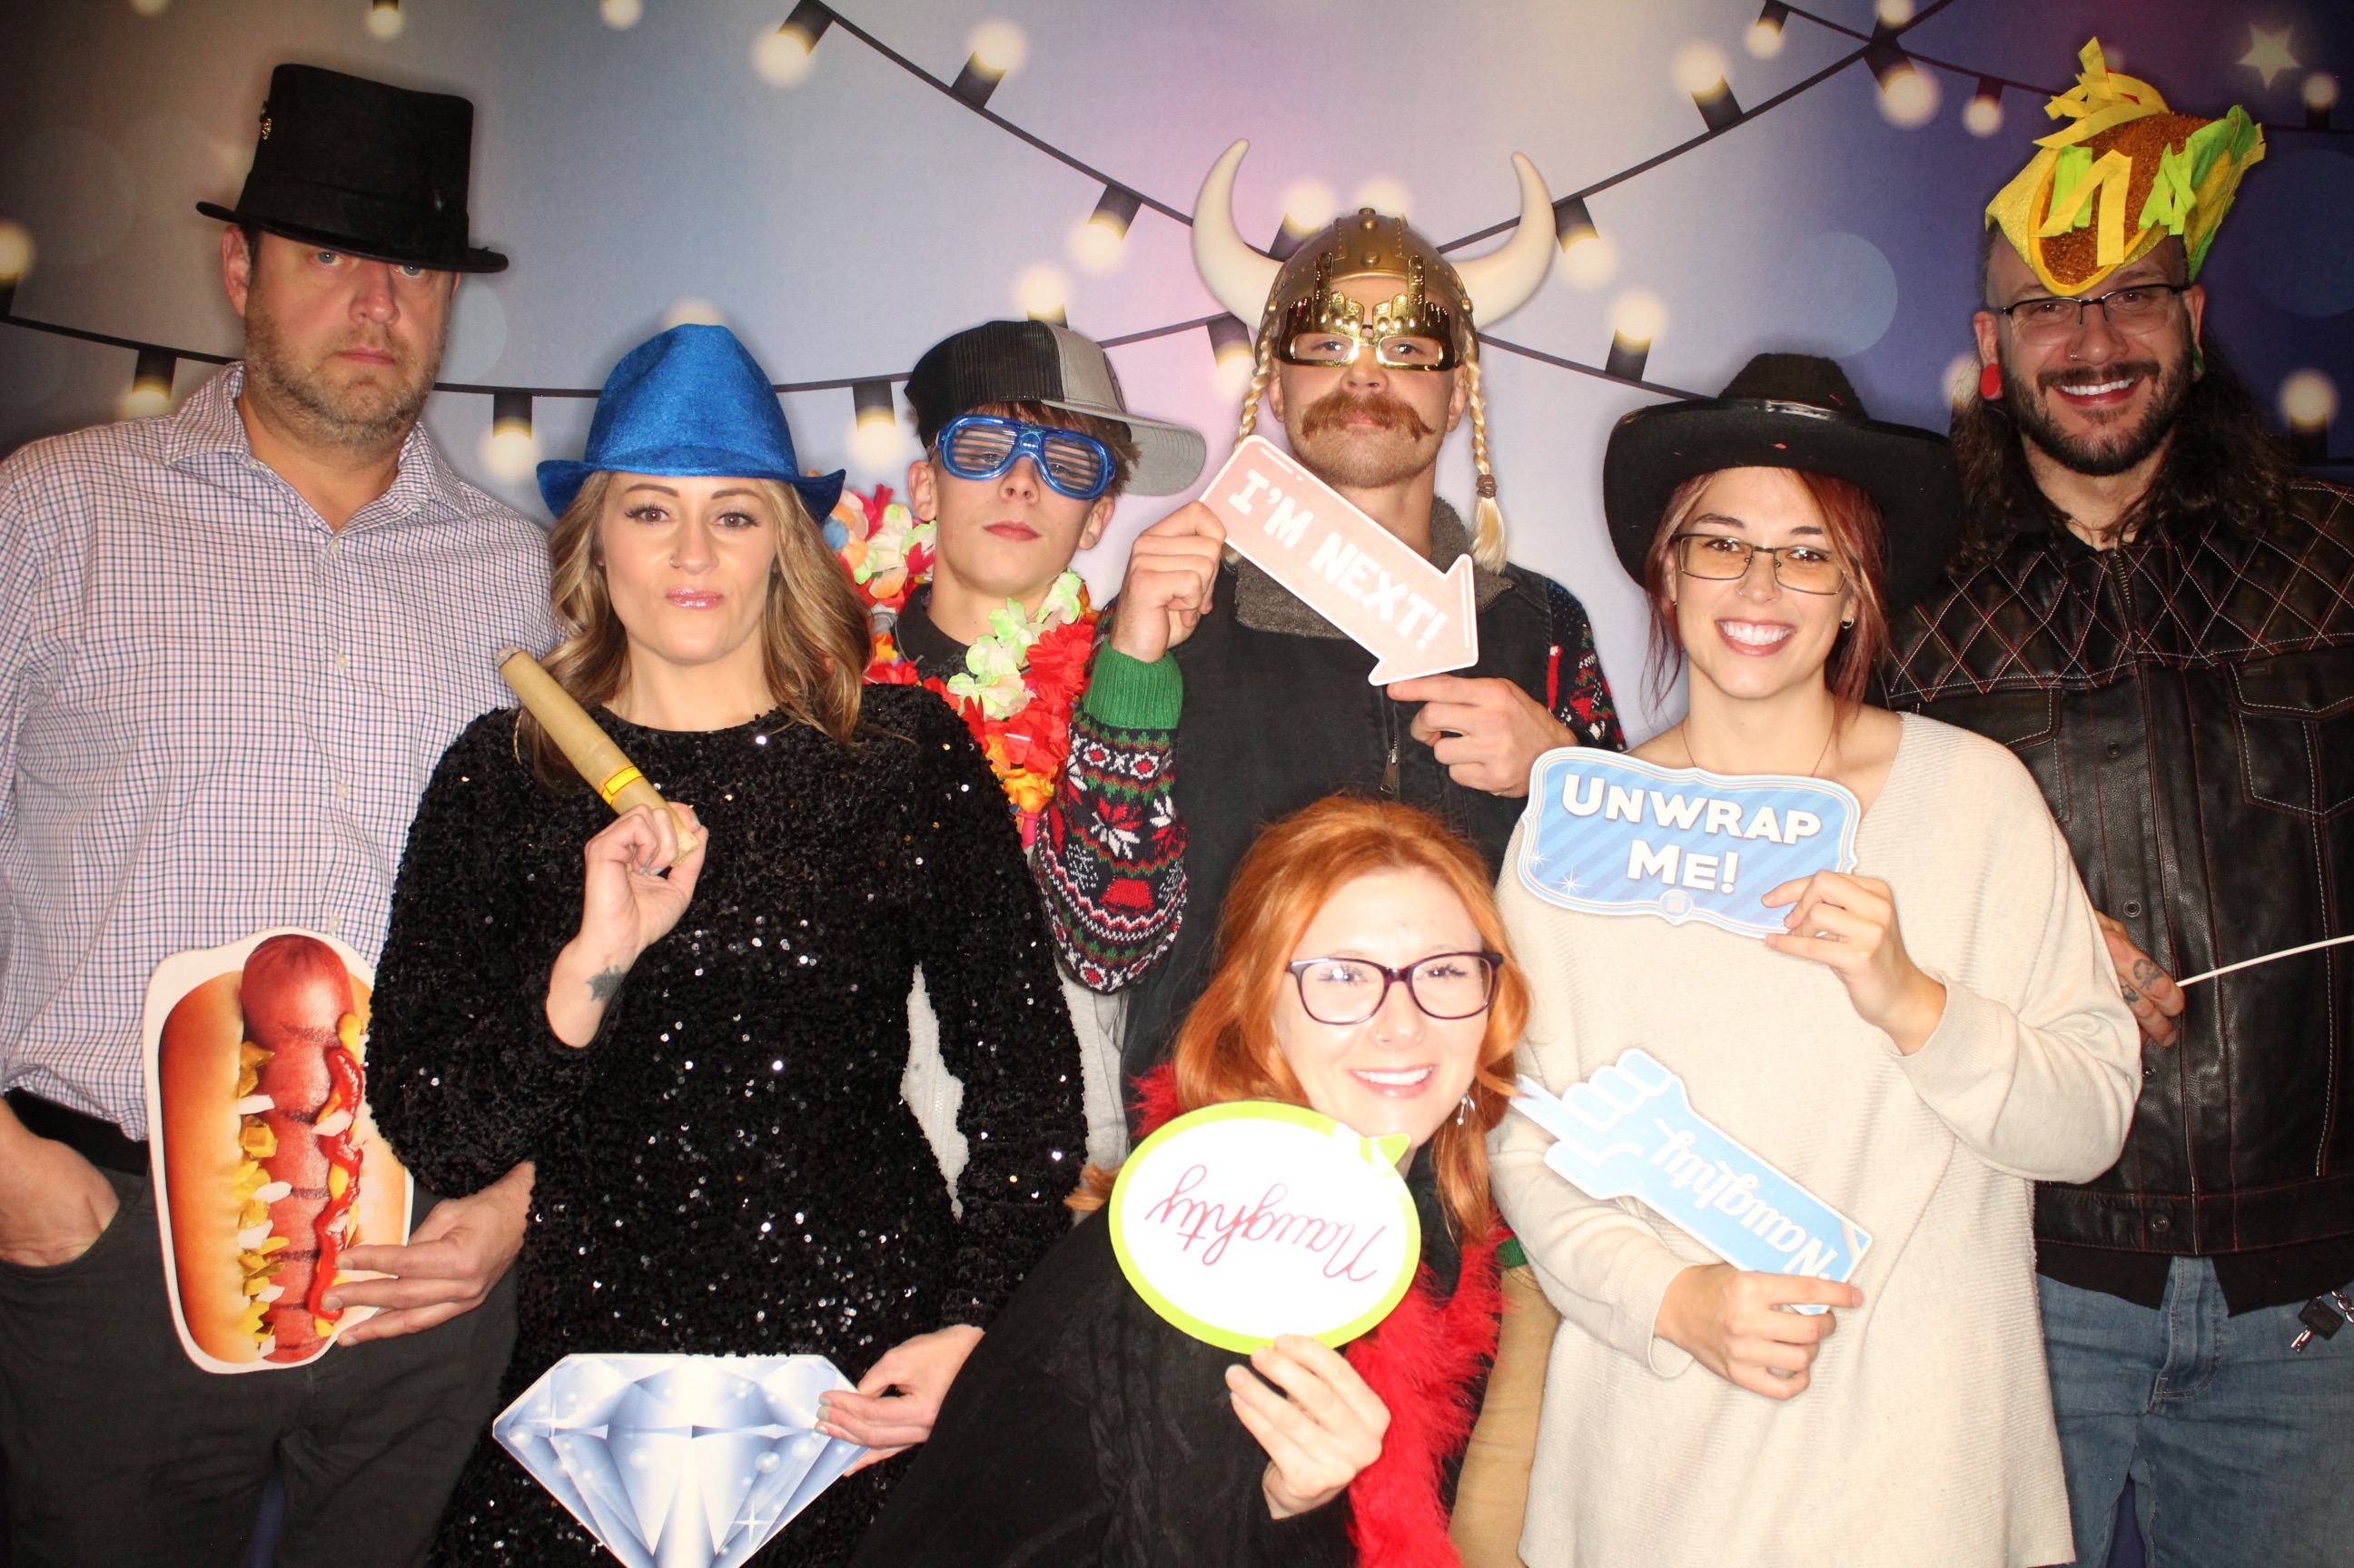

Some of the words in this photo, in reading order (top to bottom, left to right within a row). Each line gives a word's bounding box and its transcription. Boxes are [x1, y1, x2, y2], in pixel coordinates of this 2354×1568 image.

[1228, 469, 1313, 548] I'M
[1310, 532, 1447, 650] NEXT!
[1562, 774, 1821, 845] UNWRAP
[1627, 839, 1739, 894] ME!
[1144, 1164, 1386, 1282] Naughty
[1652, 1118, 1838, 1277] Naughty
